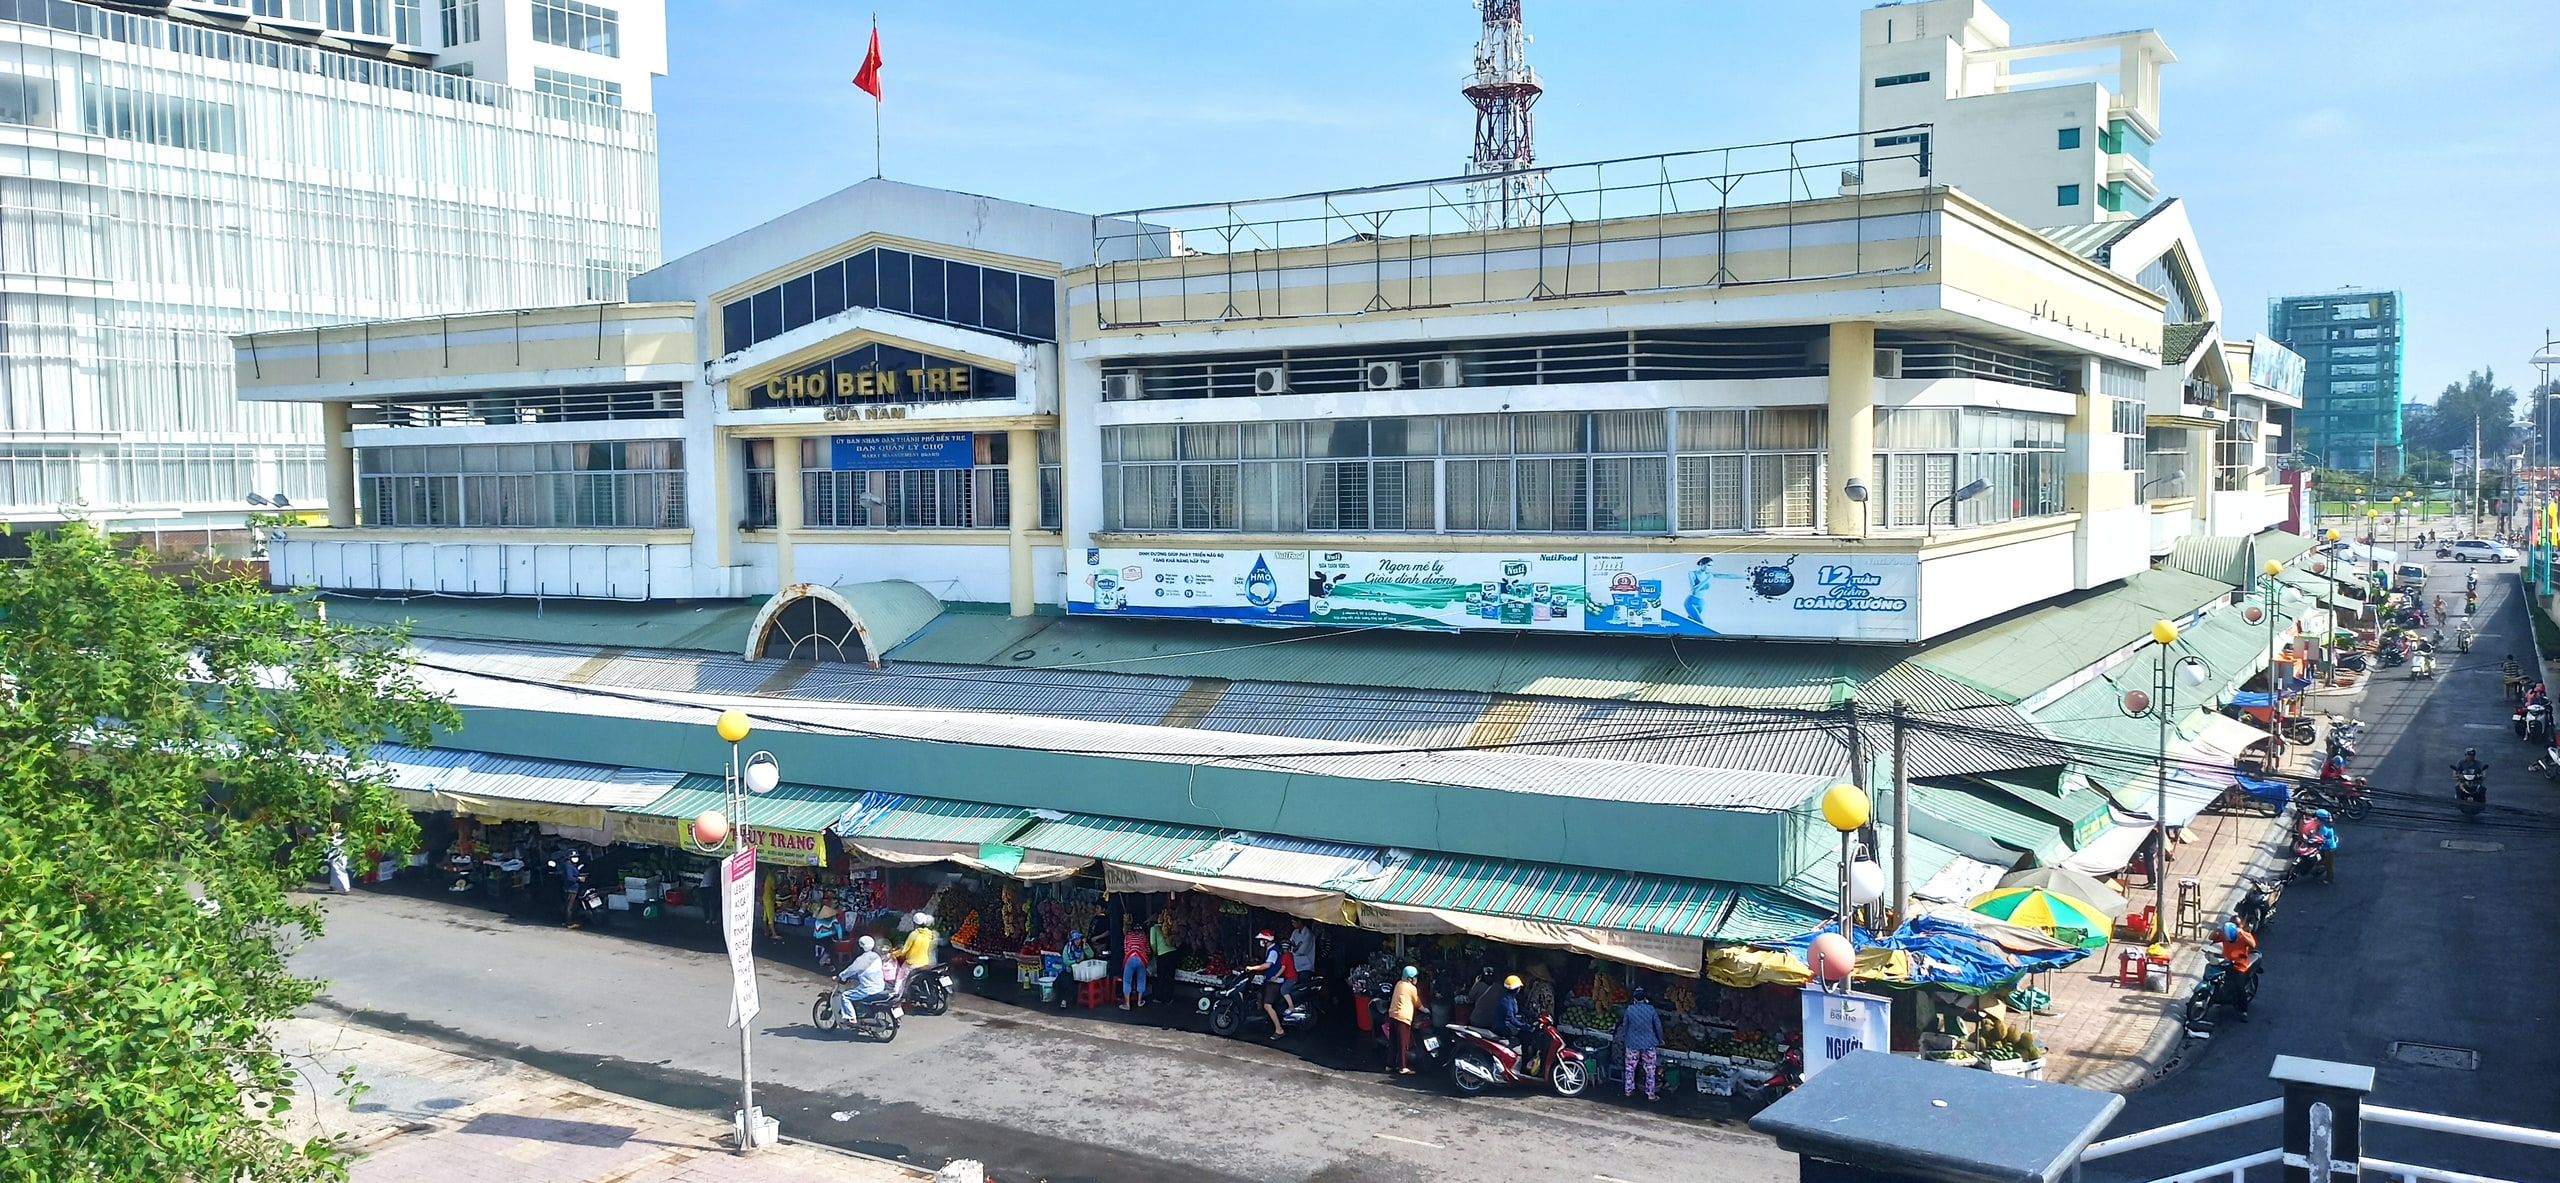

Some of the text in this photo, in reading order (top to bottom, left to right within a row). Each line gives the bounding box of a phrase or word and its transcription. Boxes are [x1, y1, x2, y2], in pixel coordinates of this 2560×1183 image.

[767, 370, 827, 401] CHỢ
[907, 367, 969, 393] TRE
[865, 407, 906, 420] NAM
[1379, 558, 1410, 574] Ngon
[1433, 560, 1444, 575] ly
[1506, 563, 1526, 576] Nuti
[1250, 573, 1271, 581] HMO
[1365, 572, 1393, 584] Giàu
[1395, 573, 1420, 585] dinh
[1820, 566, 1851, 585] 12
[1849, 597, 1906, 610] XƯƠNG
[768, 832, 815, 850] TRANG
